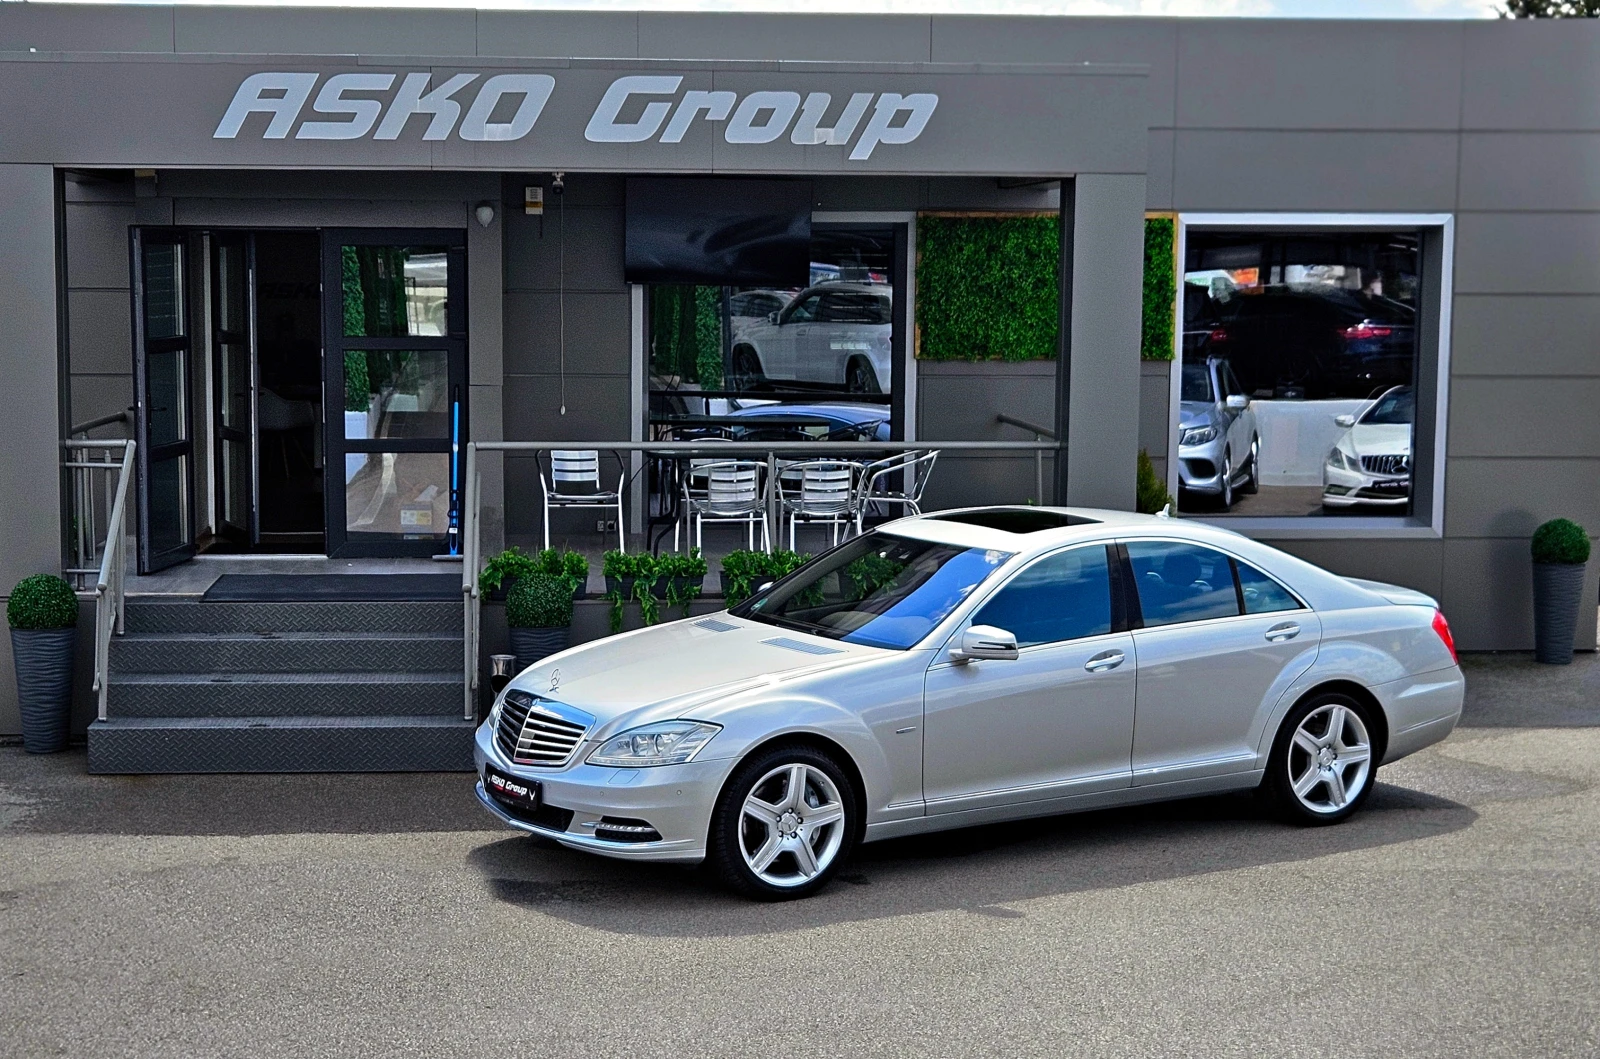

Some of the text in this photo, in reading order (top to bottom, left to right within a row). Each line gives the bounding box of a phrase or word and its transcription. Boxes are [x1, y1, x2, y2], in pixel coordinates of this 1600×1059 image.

[212, 72, 939, 160] ASKO Group
[491, 774, 527, 795] ASKO Group
